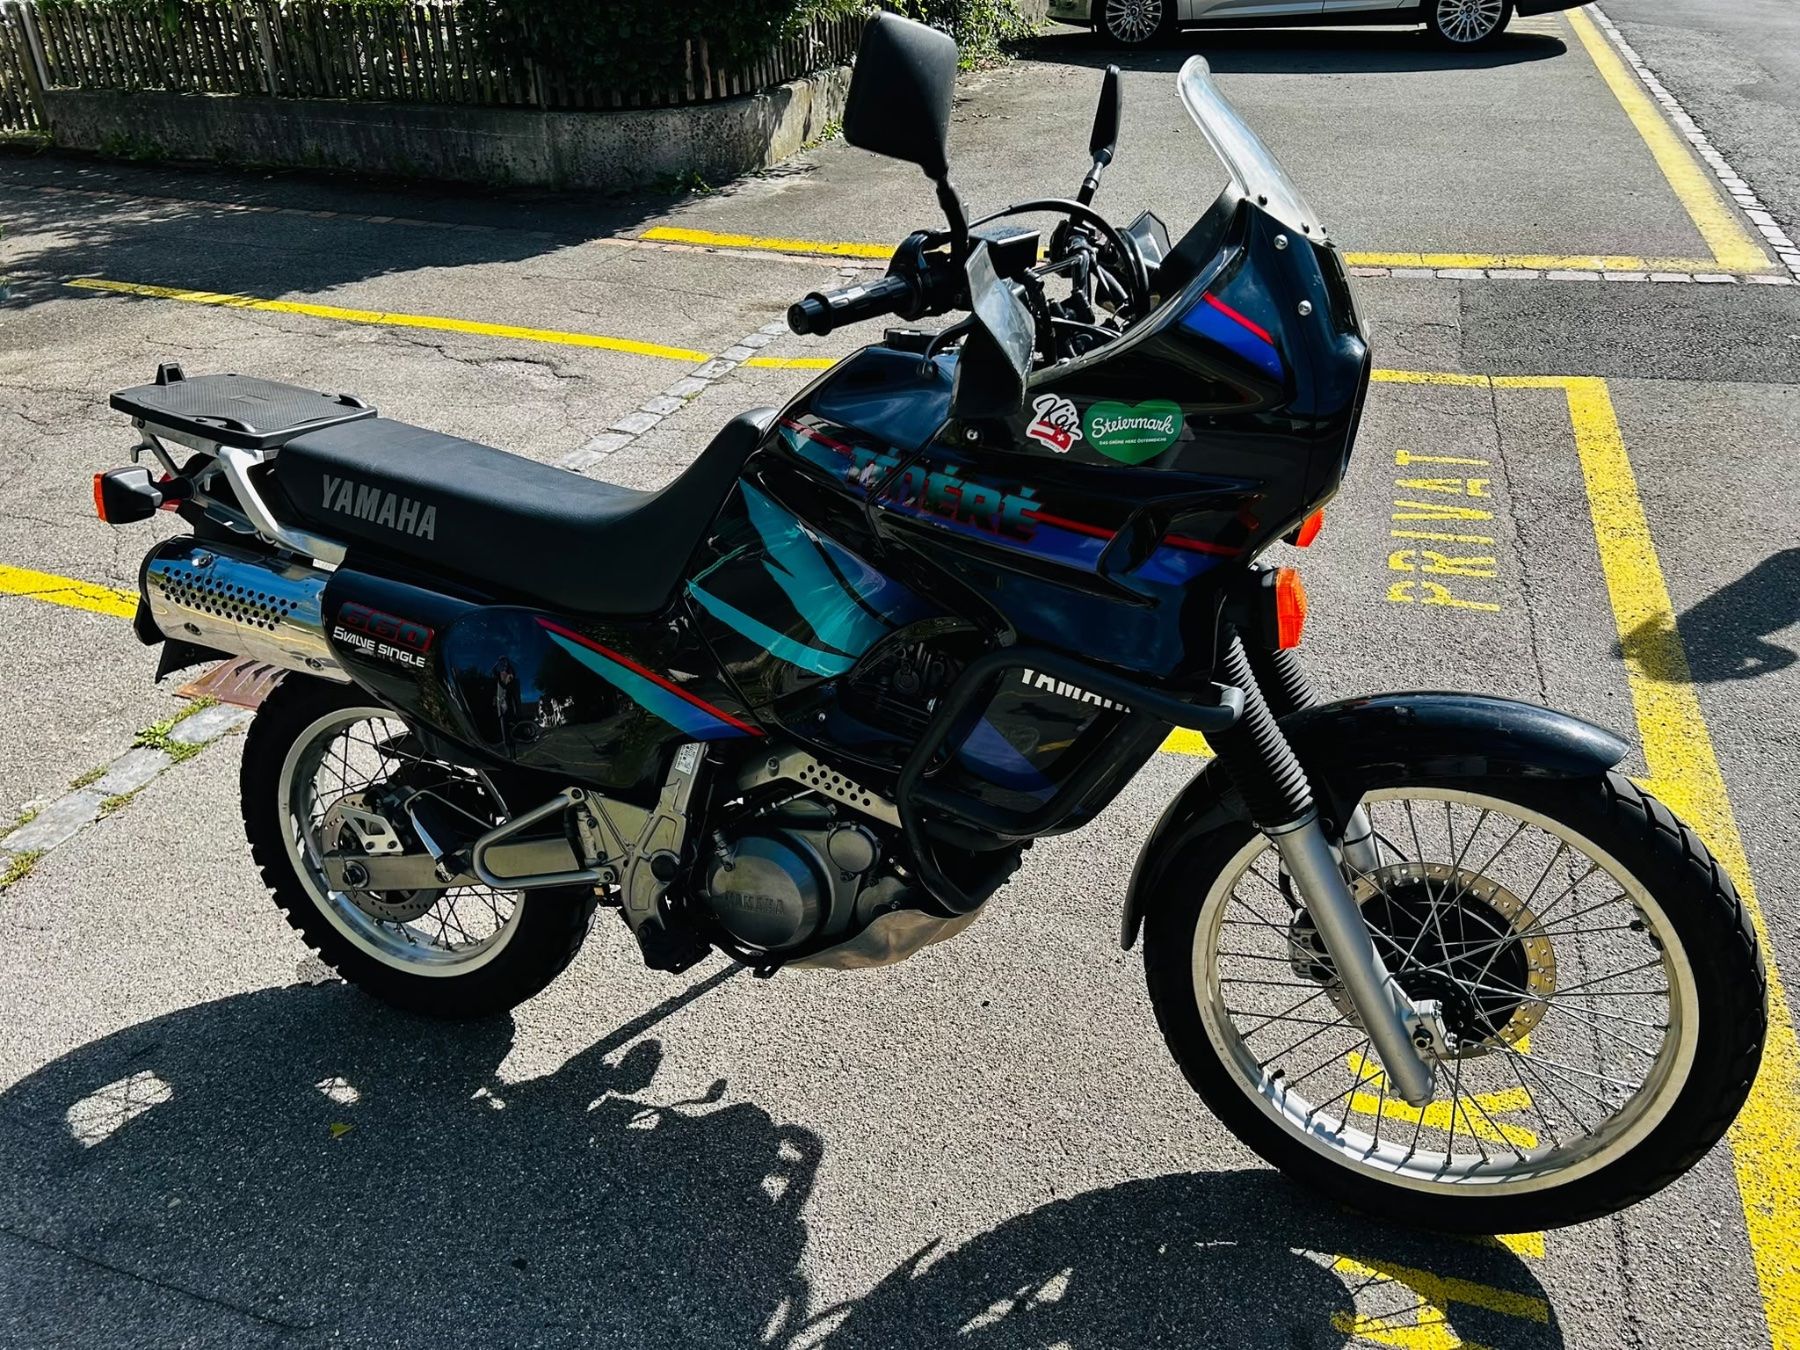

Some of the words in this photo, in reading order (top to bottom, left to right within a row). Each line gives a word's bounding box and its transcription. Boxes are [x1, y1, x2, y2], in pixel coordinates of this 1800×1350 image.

[1091, 414, 1174, 439] Steiermark
[321, 473, 437, 541] YAMAHA
[1385, 449, 1501, 612] PRIVAT
[378, 643, 426, 668] SINGLE
